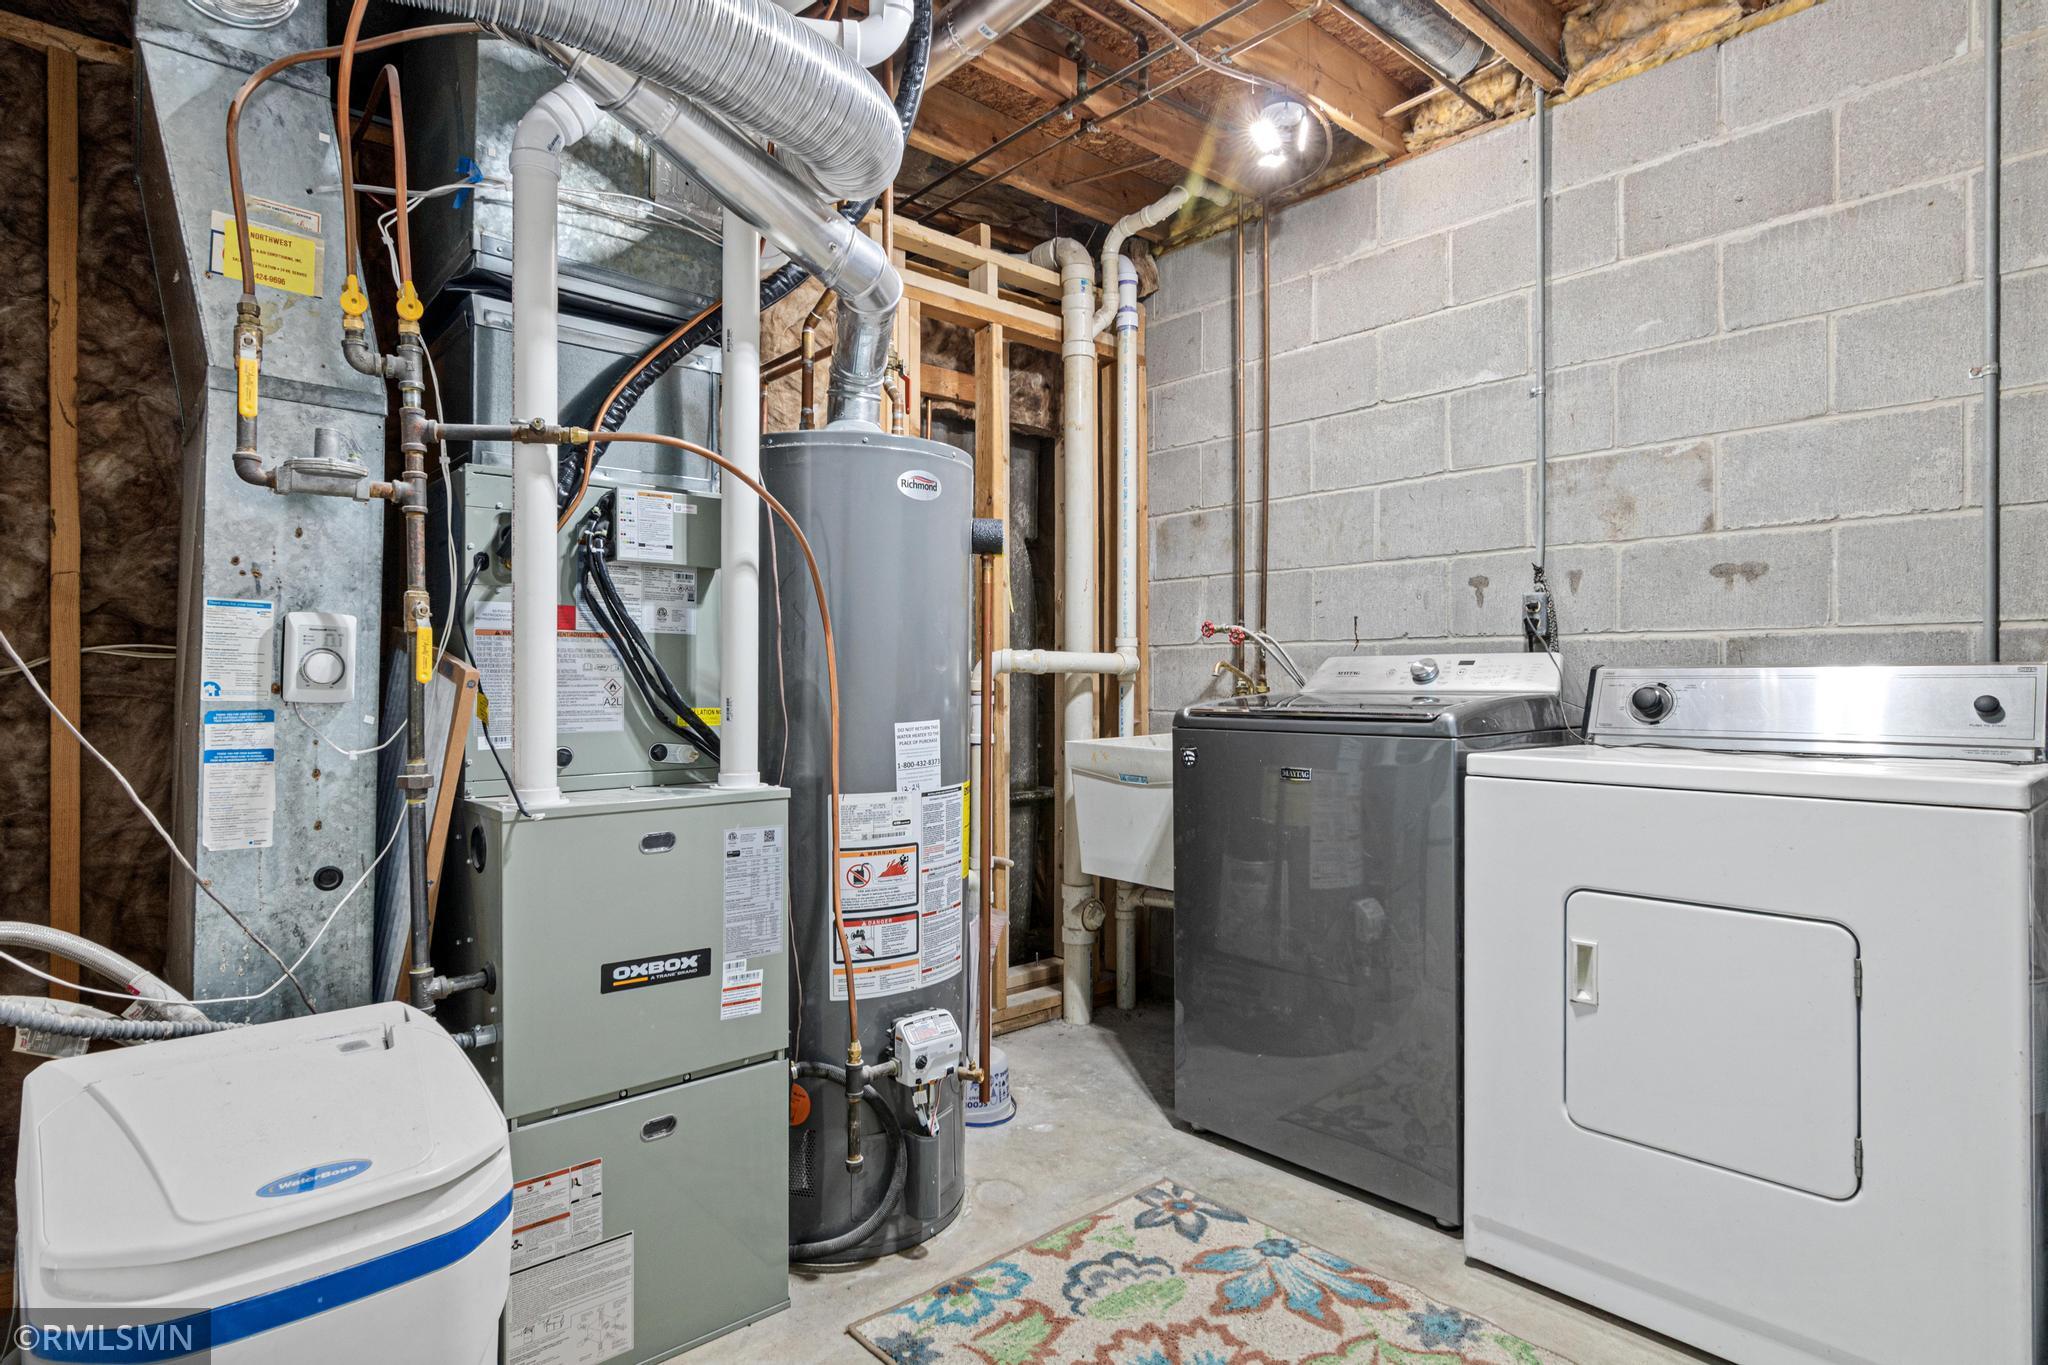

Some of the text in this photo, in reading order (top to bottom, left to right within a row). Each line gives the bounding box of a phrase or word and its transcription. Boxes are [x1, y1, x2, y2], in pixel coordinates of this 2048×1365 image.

[250, 232, 292, 247] NORTHWEST
[901, 478, 938, 491] Richmond
[603, 698, 623, 706] A2L
[1281, 770, 1310, 779] MAYTAG
[867, 849, 897, 857] WARNING
[867, 918, 893, 926] DANGER
[612, 954, 699, 980] OXBOX
[677, 968, 698, 976] BRAND
[278, 1165, 358, 1190] WaterBoss
